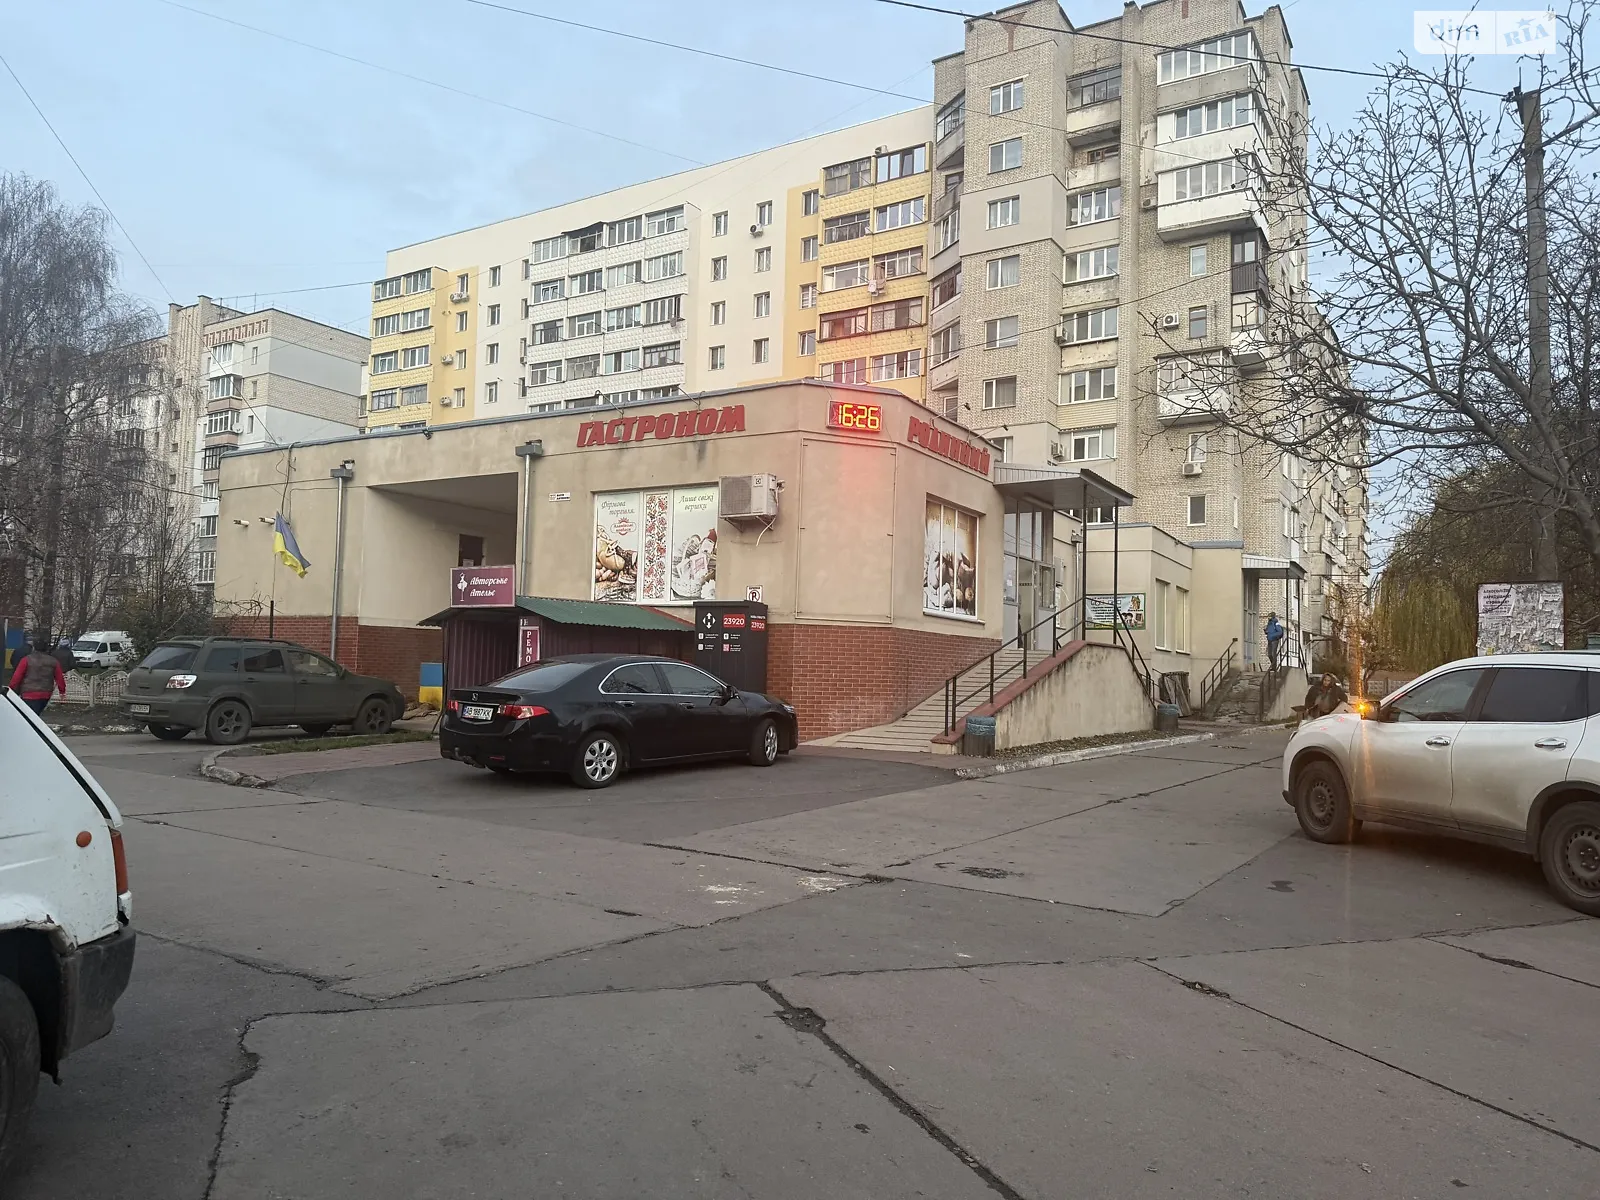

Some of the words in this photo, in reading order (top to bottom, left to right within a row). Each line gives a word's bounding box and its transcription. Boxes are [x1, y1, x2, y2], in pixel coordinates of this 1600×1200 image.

[576, 404, 746, 447] ГАСТРОНОМ
[838, 403, 880, 429] 16:26
[469, 576, 509, 587] Авторське
[723, 617, 745, 626] 23920
[525, 630, 533, 664] РЕМО
